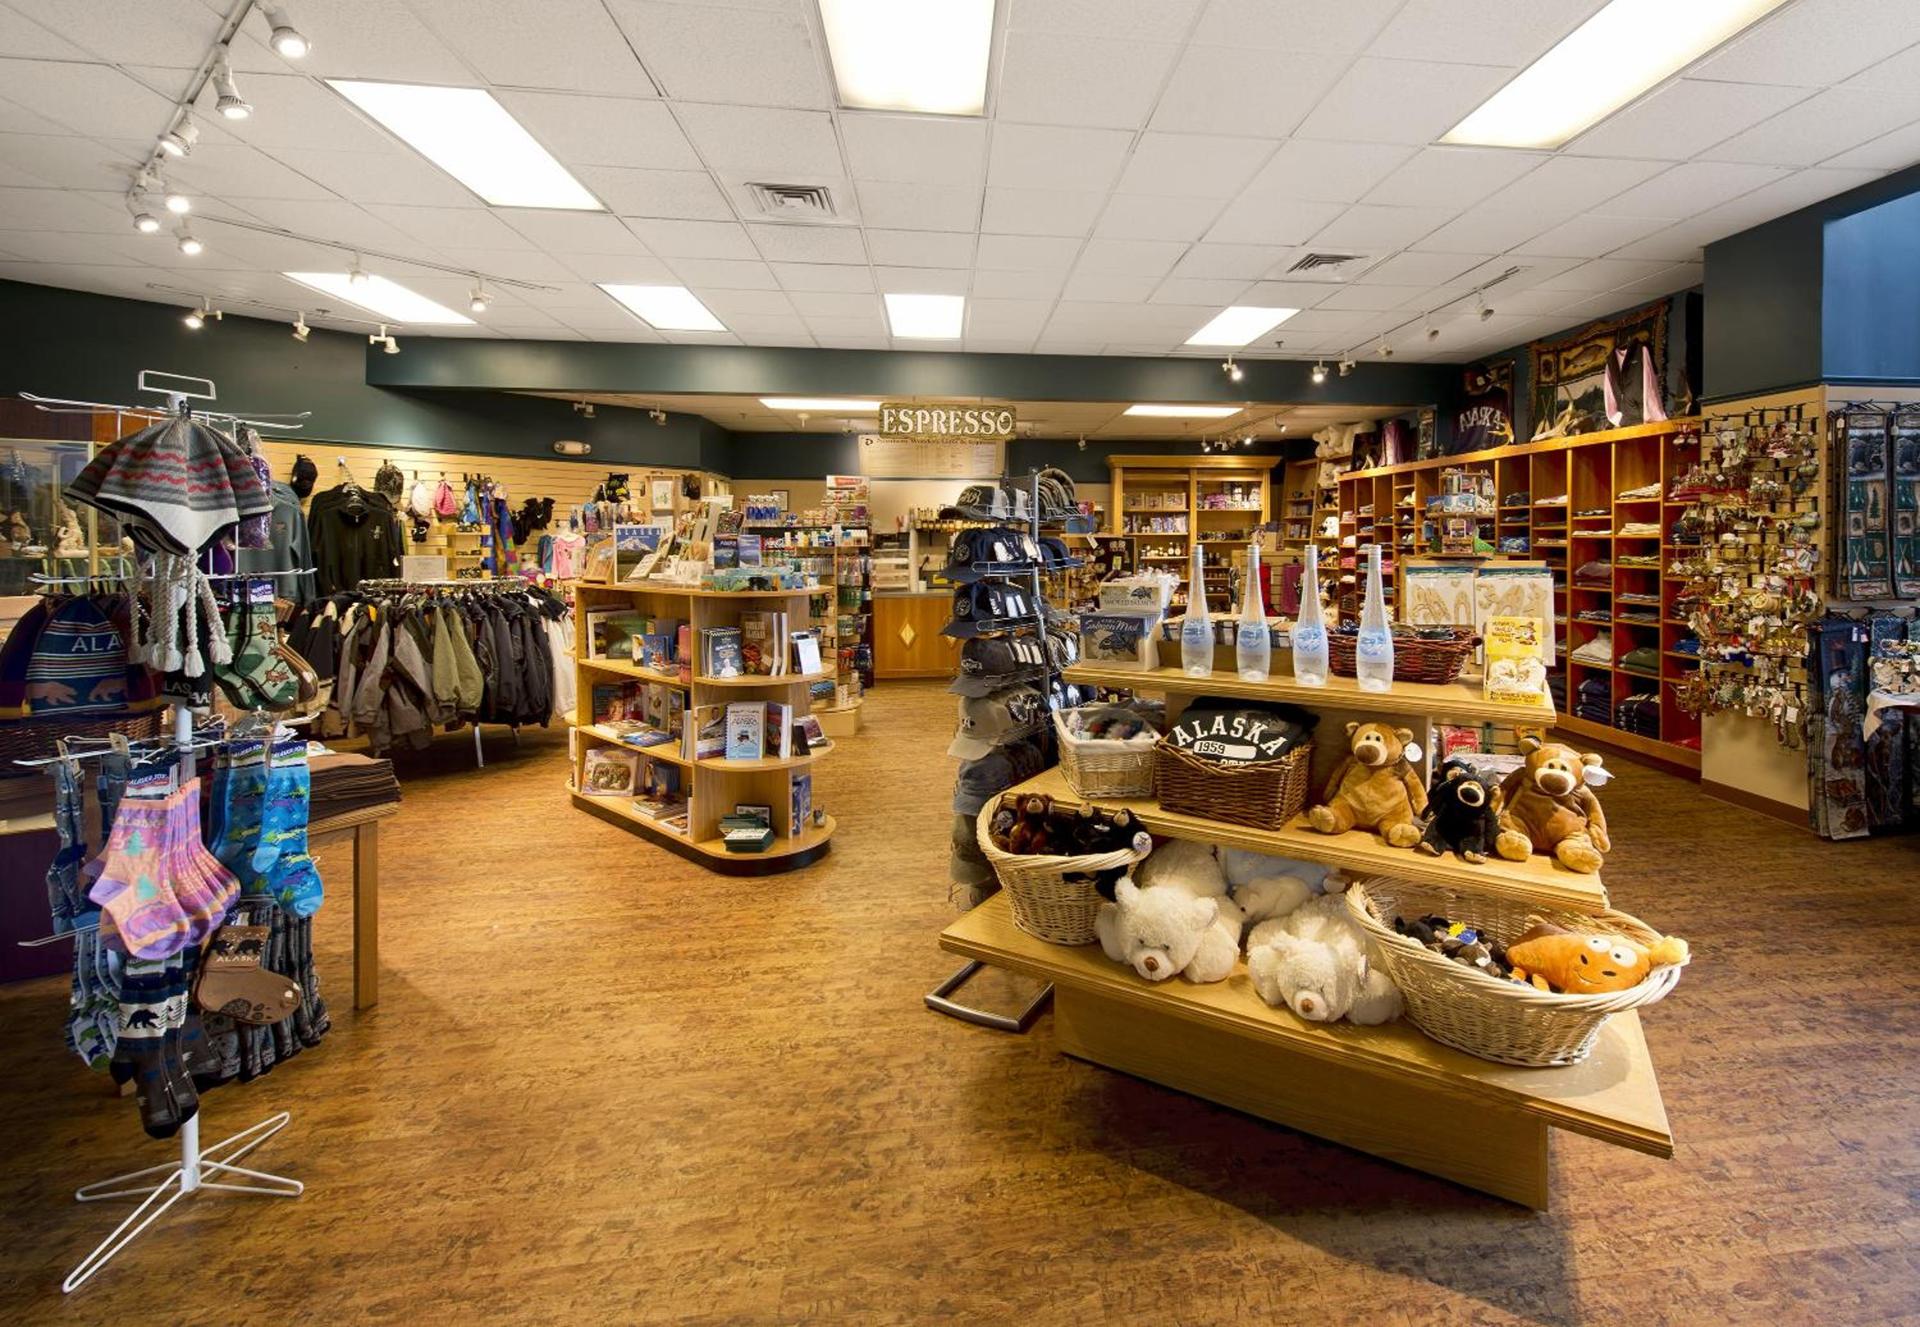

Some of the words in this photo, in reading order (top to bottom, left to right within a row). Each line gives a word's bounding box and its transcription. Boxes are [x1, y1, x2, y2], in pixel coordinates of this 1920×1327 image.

[882, 408, 1013, 434] ESPRESSO
[1460, 406, 1505, 432] ALASKA
[616, 527, 661, 536] ALASKA
[1173, 715, 1288, 756] ALASKA
[1198, 742, 1225, 755] 1959
[216, 954, 261, 963] ALASKA
